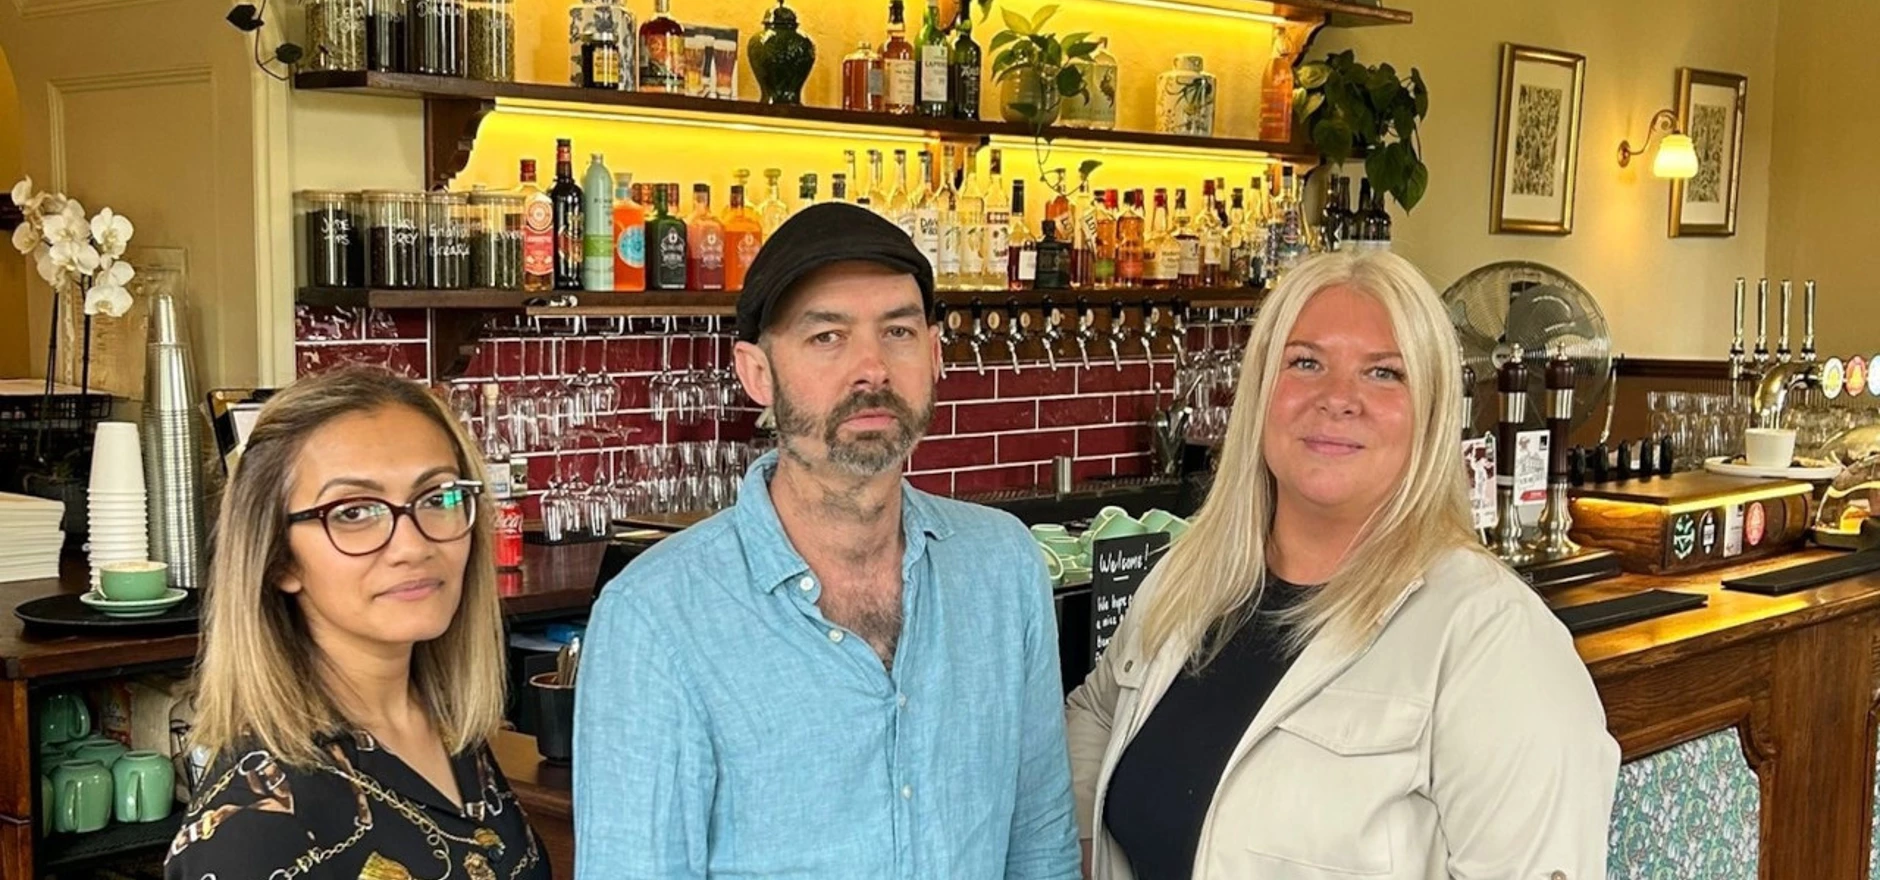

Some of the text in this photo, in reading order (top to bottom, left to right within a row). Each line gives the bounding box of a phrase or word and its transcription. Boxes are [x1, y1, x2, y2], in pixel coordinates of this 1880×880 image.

[321, 216, 350, 234] JDE
[1099, 543, 1150, 573] Welcome!
[1097, 595, 1109, 612] We
